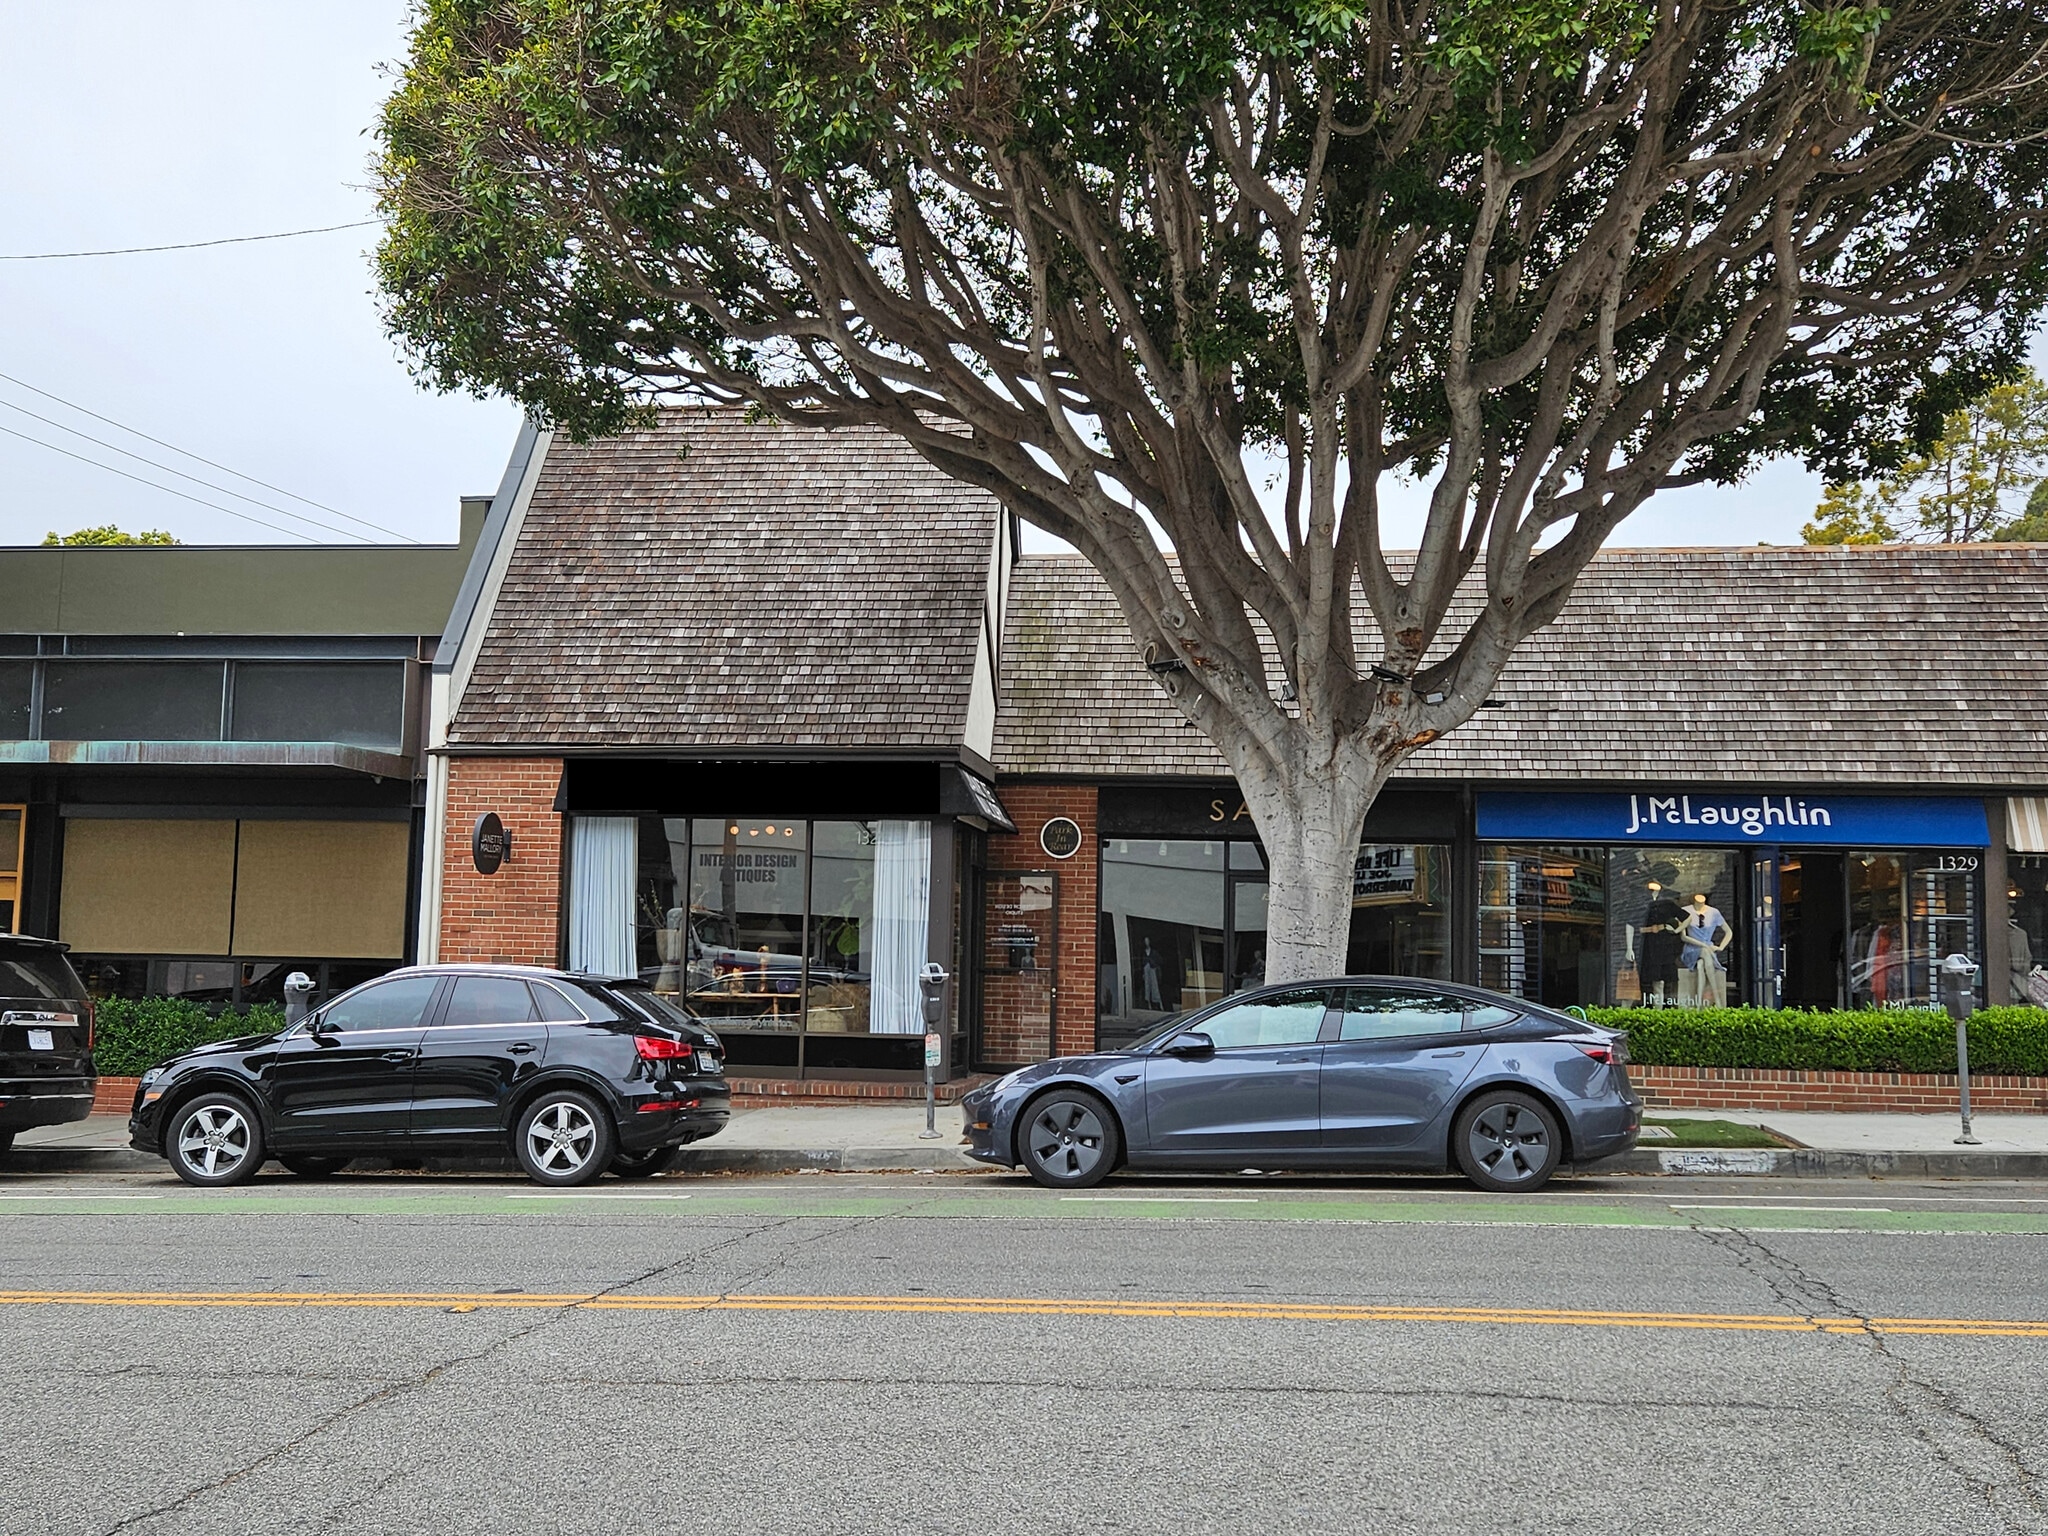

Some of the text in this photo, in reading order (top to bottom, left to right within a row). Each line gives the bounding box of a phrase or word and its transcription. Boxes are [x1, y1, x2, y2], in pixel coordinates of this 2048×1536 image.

[1626, 794, 1831, 835] J.McLaughlin
[481, 833, 503, 844] JANETTE
[699, 853, 798, 868] INTEOR DESIGN
[1938, 856, 1979, 871] 1329
[735, 869, 776, 883] TIQUES
